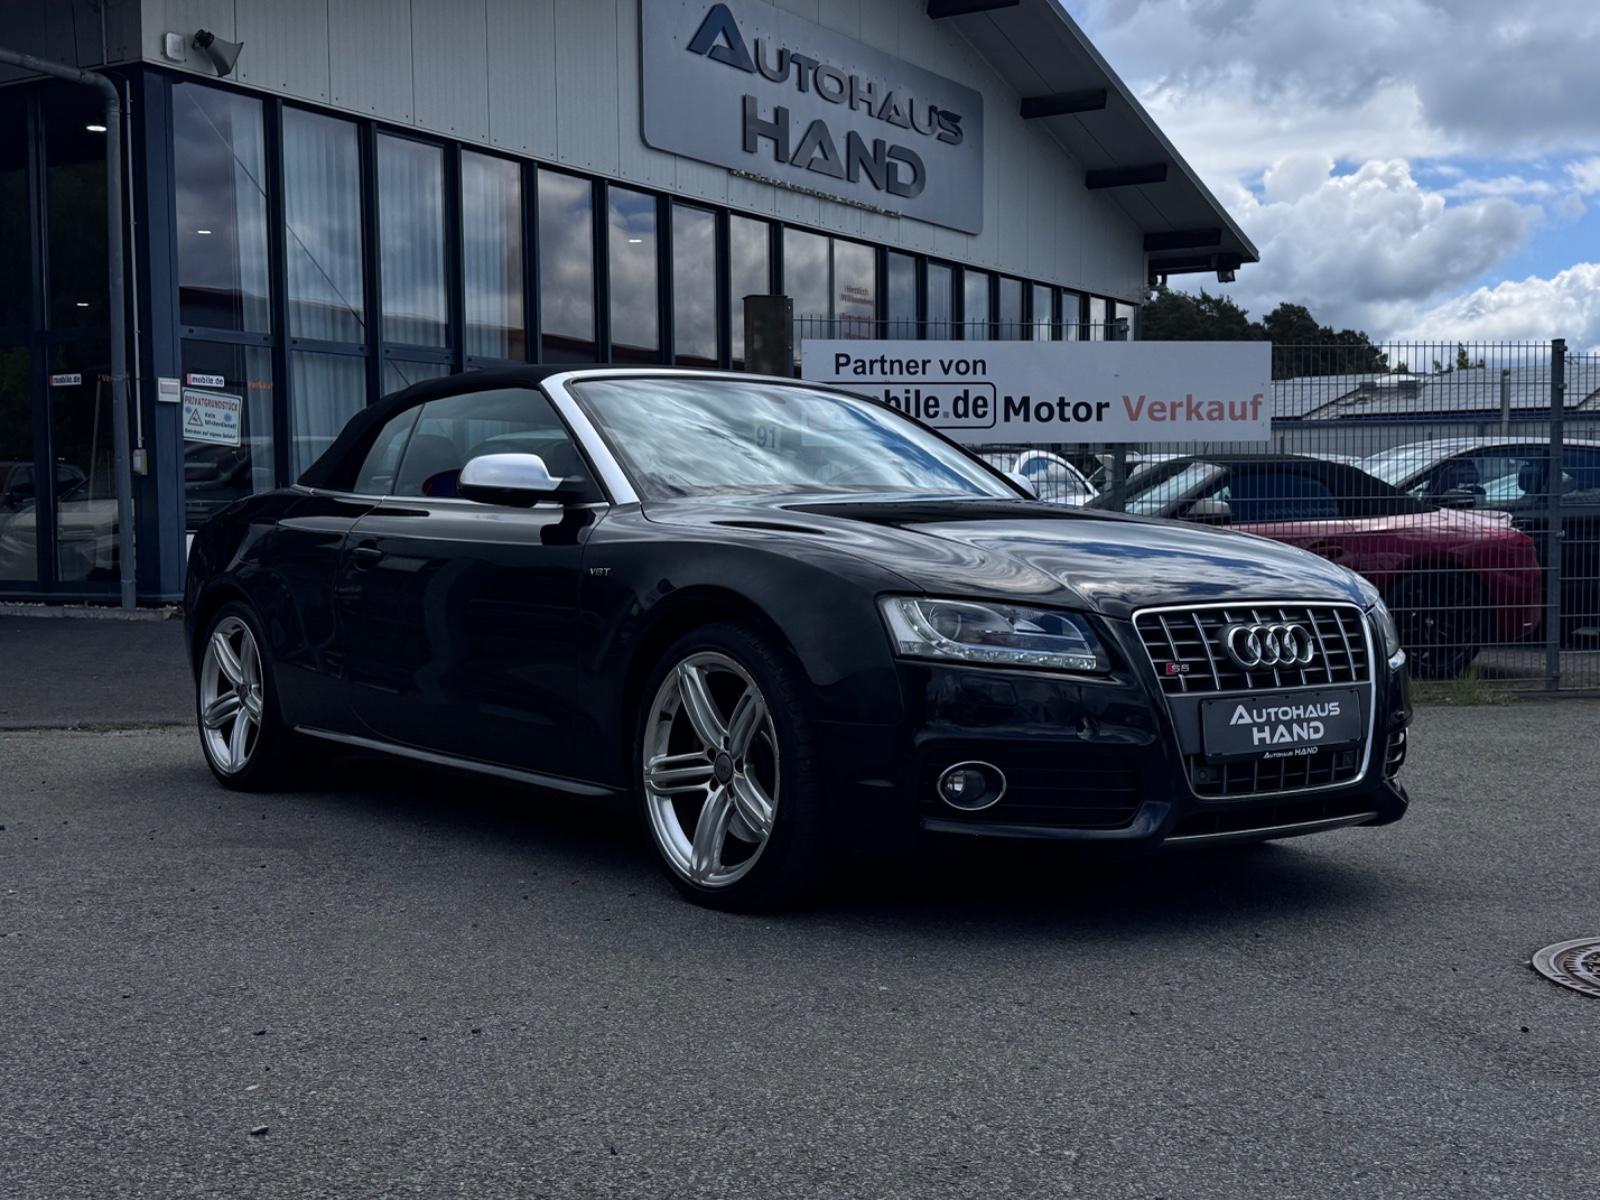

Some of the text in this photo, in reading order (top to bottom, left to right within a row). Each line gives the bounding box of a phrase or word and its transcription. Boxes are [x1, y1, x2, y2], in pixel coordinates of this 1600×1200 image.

[686, 2, 964, 146] AUTOHAUS
[741, 93, 926, 199] HAND
[834, 353, 987, 376] Partner von
[192, 376, 224, 385] mobile.de
[185, 395, 238, 411] PRIVATGRUNDSTÜCK
[874, 389, 1264, 423] bile.de Motor Verkauf
[757, 427, 775, 448] 91
[1171, 663, 1190, 673] S5
[1229, 702, 1341, 725] AUTOHAUS
[1252, 721, 1325, 745] HAND
[1294, 746, 1319, 756] HAND
